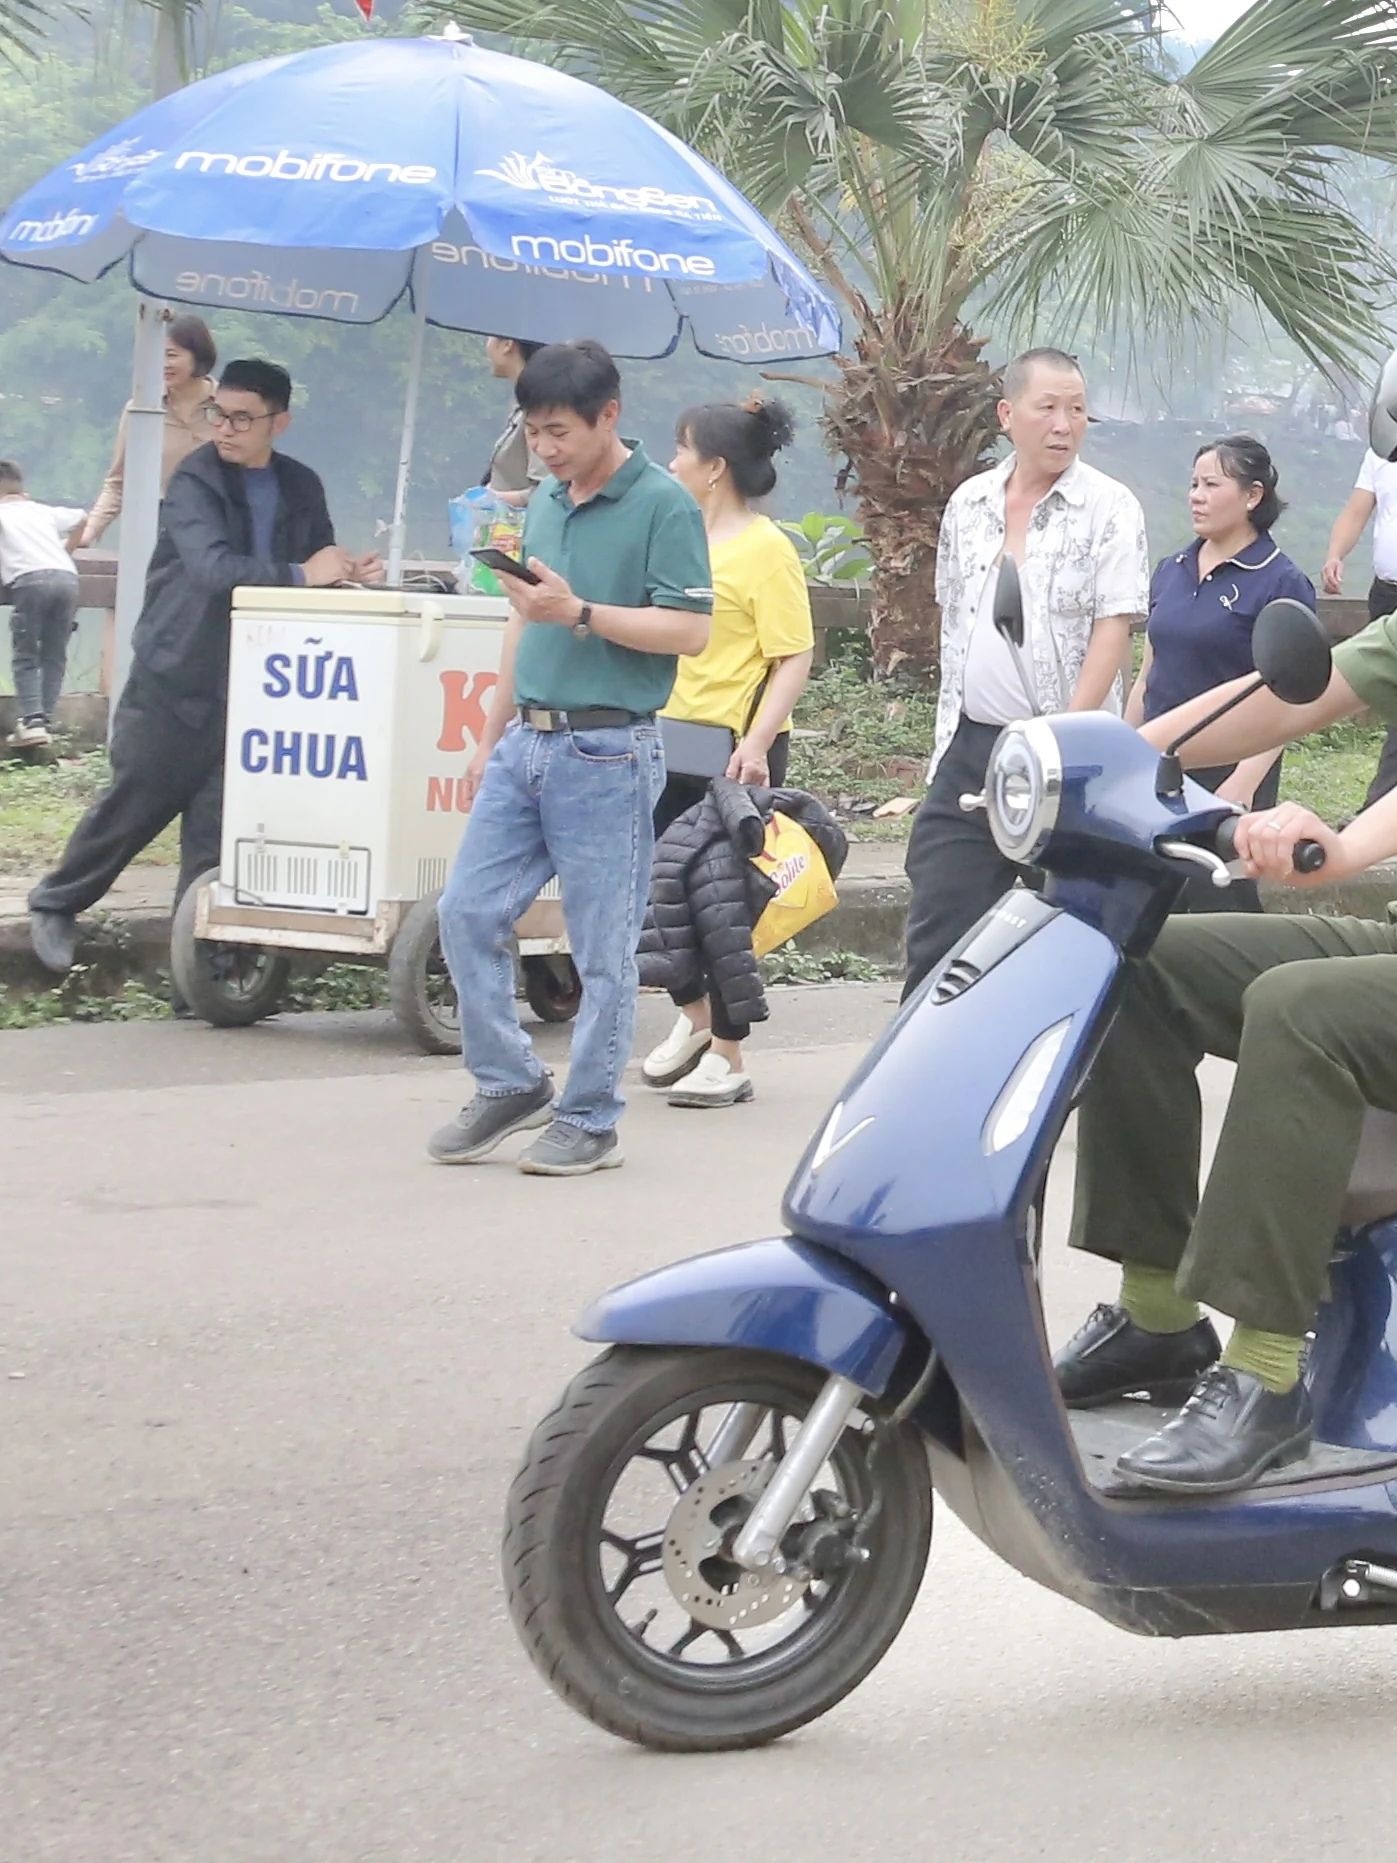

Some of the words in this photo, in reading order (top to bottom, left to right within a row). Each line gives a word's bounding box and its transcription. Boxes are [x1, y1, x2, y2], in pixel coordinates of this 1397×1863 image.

[174, 150, 437, 184] mobifone
[511, 234, 715, 276] mobifone
[263, 637, 360, 701] SỮA
[240, 728, 368, 782] CHUA
